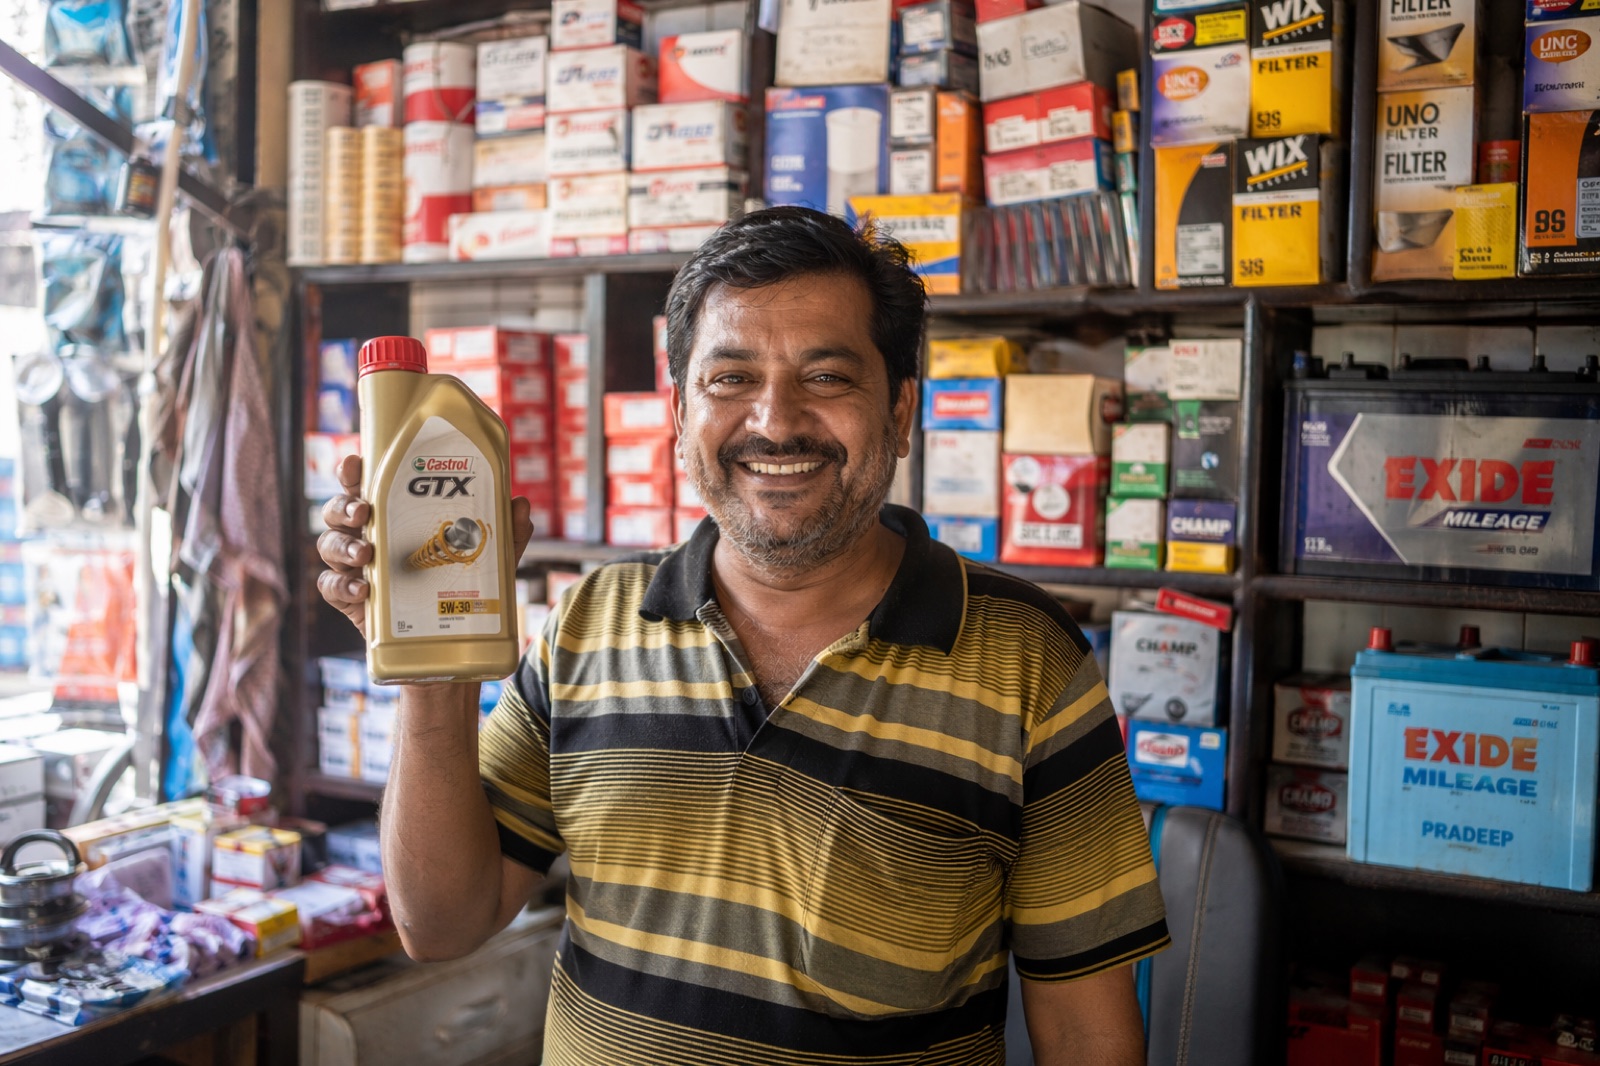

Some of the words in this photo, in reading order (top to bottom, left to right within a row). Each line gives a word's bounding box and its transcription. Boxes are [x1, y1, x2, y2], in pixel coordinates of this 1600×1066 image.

[1261, 0, 1325, 30] WIX
[1391, 0, 1451, 14] FILTER
[1258, 56, 1319, 74] FILTER
[1387, 103, 1439, 126] UNO
[1386, 127, 1438, 141] FILTER
[1244, 134, 1308, 176] WIX
[1384, 151, 1446, 175] FILTER
[1241, 205, 1302, 220] FILTER
[426, 458, 469, 471] Castrol
[407, 476, 476, 499] GTX
[1384, 455, 1555, 505] EXIDE
[1171, 516, 1232, 537] CHAMP
[1443, 511, 1543, 530] MILEAGE
[440, 601, 471, 614] 5W-30
[1136, 638, 1198, 656] CHAMP
[1404, 727, 1538, 772] EXIDE
[1402, 766, 1538, 798] MILEAGE
[1421, 820, 1514, 847] PRADEEP
